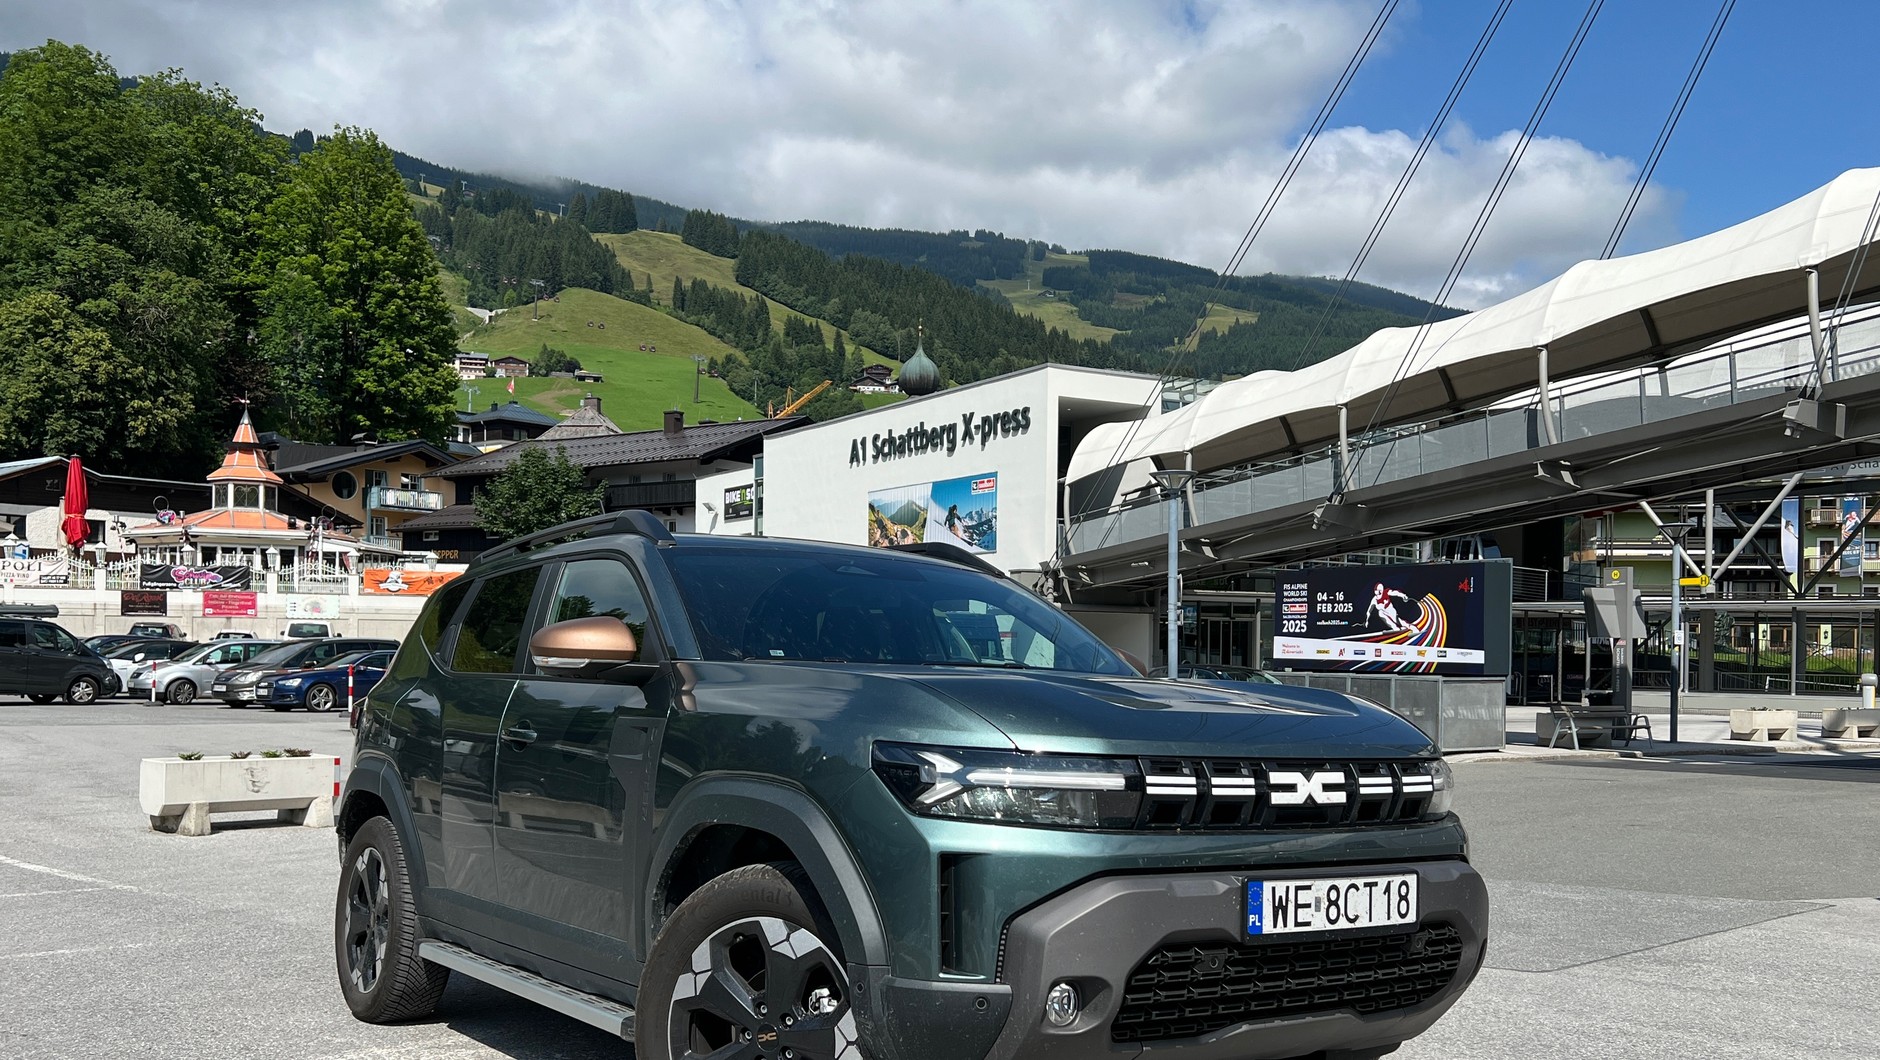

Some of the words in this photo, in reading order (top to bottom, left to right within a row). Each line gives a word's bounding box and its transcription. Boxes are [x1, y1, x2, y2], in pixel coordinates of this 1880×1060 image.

[849, 437, 867, 464] A1
[872, 421, 957, 454] Schattberg
[961, 406, 1031, 446] X-press
[1317, 592, 1327, 602] 04
[1335, 591, 1344, 602] 16
[1317, 603, 1332, 613] FEB
[1333, 603, 1353, 613] 2025
[1282, 620, 1307, 632] 2025
[1271, 885, 1312, 929] WE
[1325, 880, 1410, 925] 8CT18
[1249, 915, 1261, 926] PL
